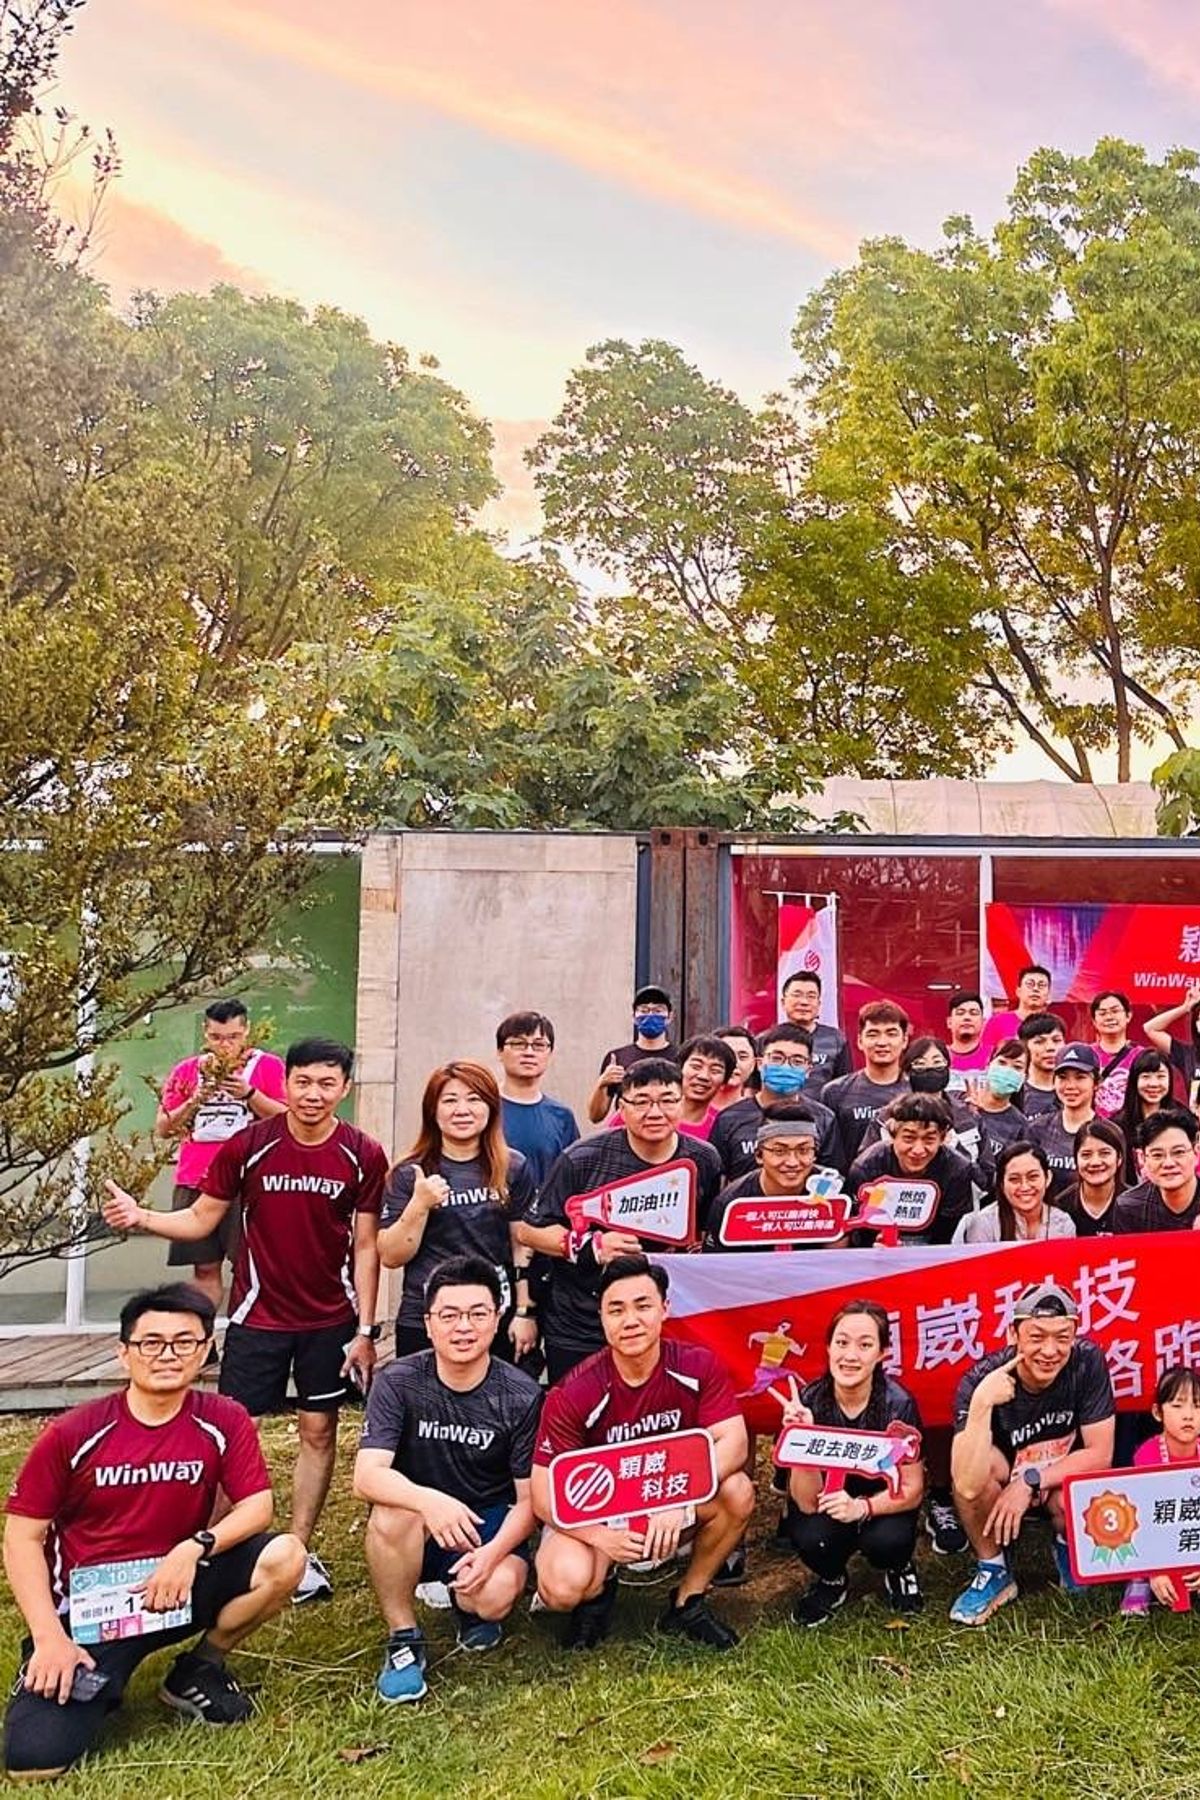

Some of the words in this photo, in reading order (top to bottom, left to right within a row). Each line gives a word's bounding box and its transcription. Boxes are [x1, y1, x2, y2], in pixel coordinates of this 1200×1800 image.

[262, 1174, 346, 1199] WinWay
[618, 1191, 679, 1214] 加油!!!
[418, 1419, 495, 1450] WinWay
[607, 1408, 681, 1443] WinWay
[790, 1438, 878, 1461] 一起去跑步
[95, 1460, 204, 1487] WinWay
[618, 1449, 667, 1480] 穎崴
[641, 1473, 690, 1502] 科技
[1103, 1508, 1118, 1532] 3
